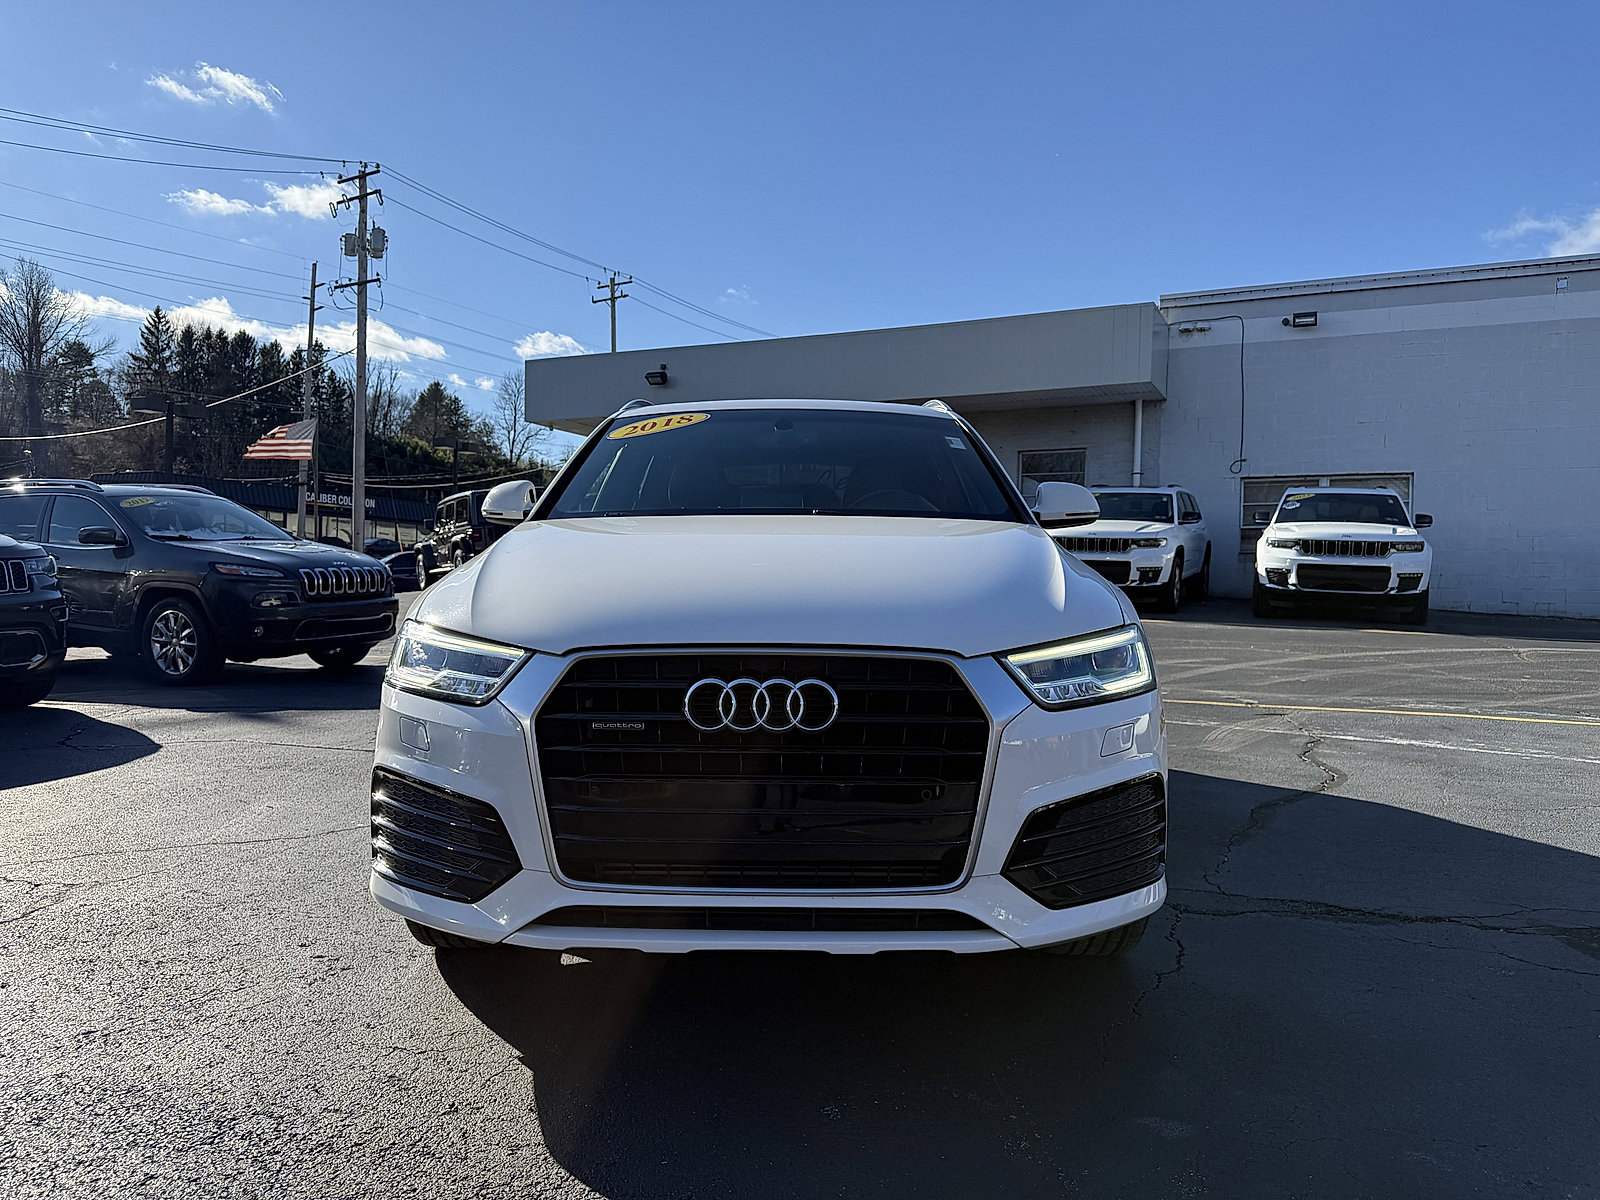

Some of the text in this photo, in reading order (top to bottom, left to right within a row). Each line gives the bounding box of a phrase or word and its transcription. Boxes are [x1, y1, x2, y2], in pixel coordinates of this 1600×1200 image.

[622, 415, 695, 437] 2018
[338, 495, 376, 509] COLON
[593, 722, 642, 730] quattro
